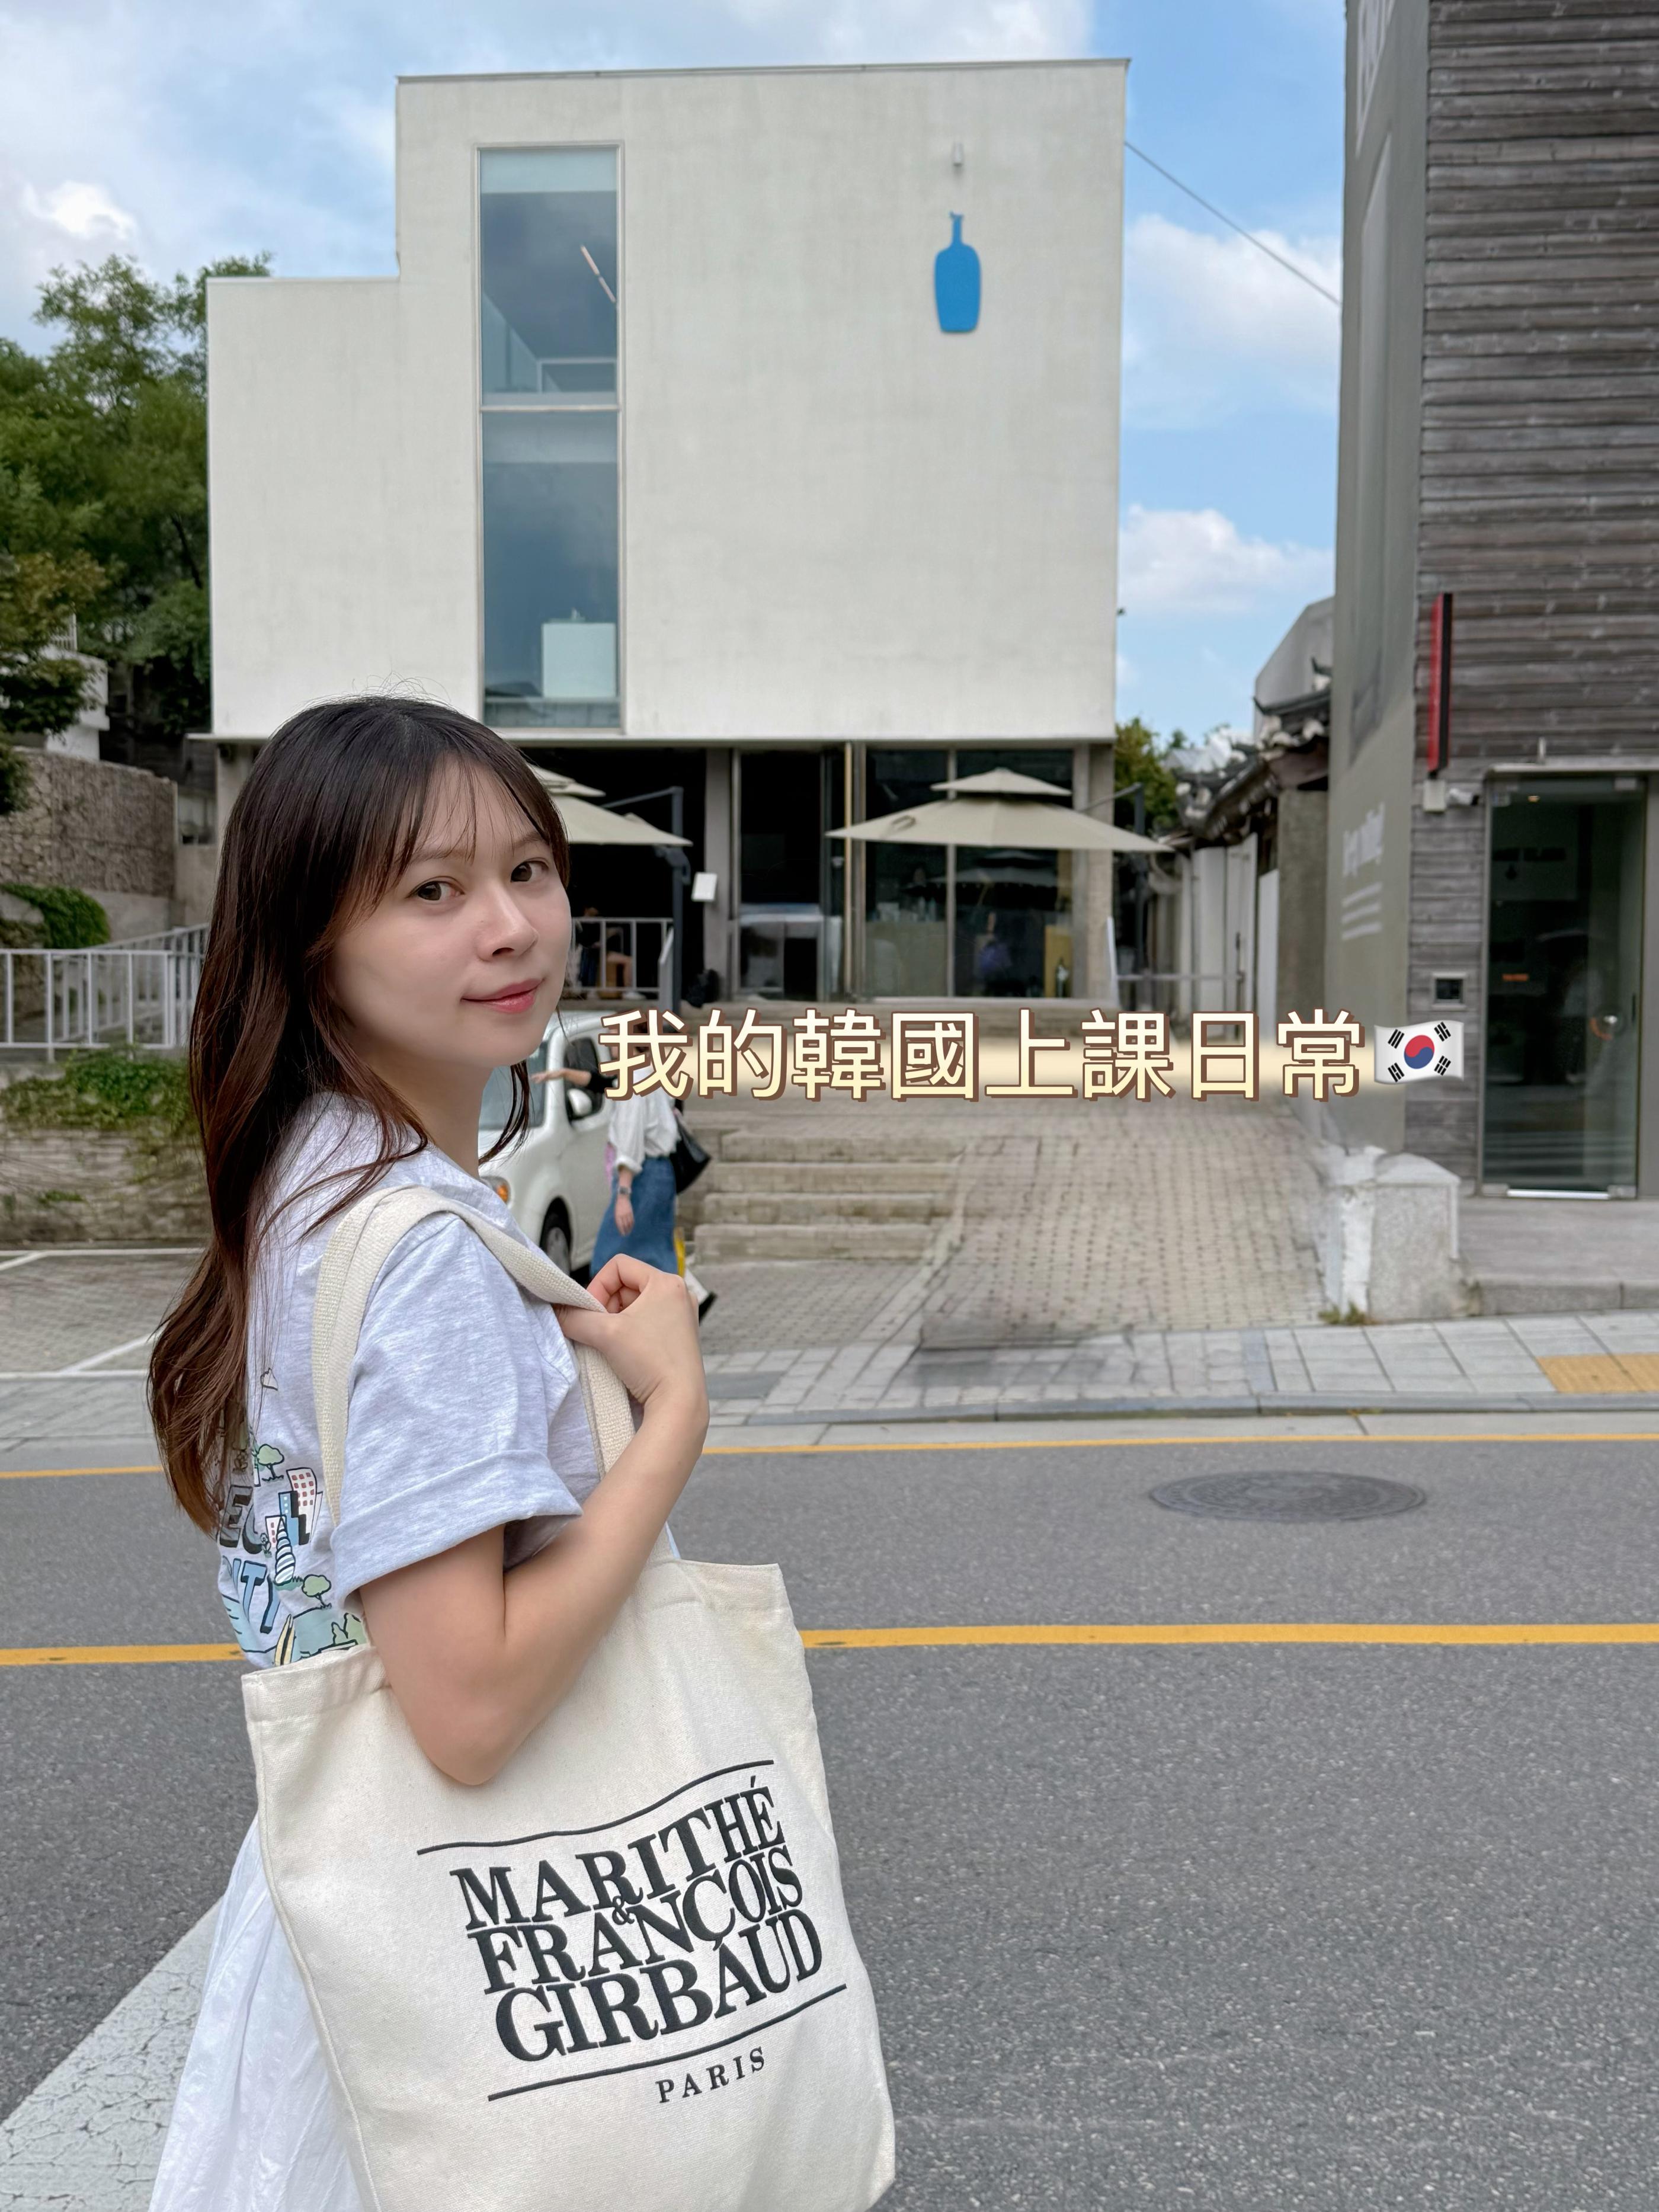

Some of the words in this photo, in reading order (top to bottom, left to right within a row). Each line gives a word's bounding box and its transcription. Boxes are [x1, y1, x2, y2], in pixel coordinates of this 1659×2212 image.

[450, 1776, 785, 1931] MARITHÉ
[467, 1845, 802, 1995] FRANÇOIS
[611, 1895, 635, 1925] &
[496, 1910, 822, 2061] GIRBAUD
[656, 2047, 766, 2103] PARIS
